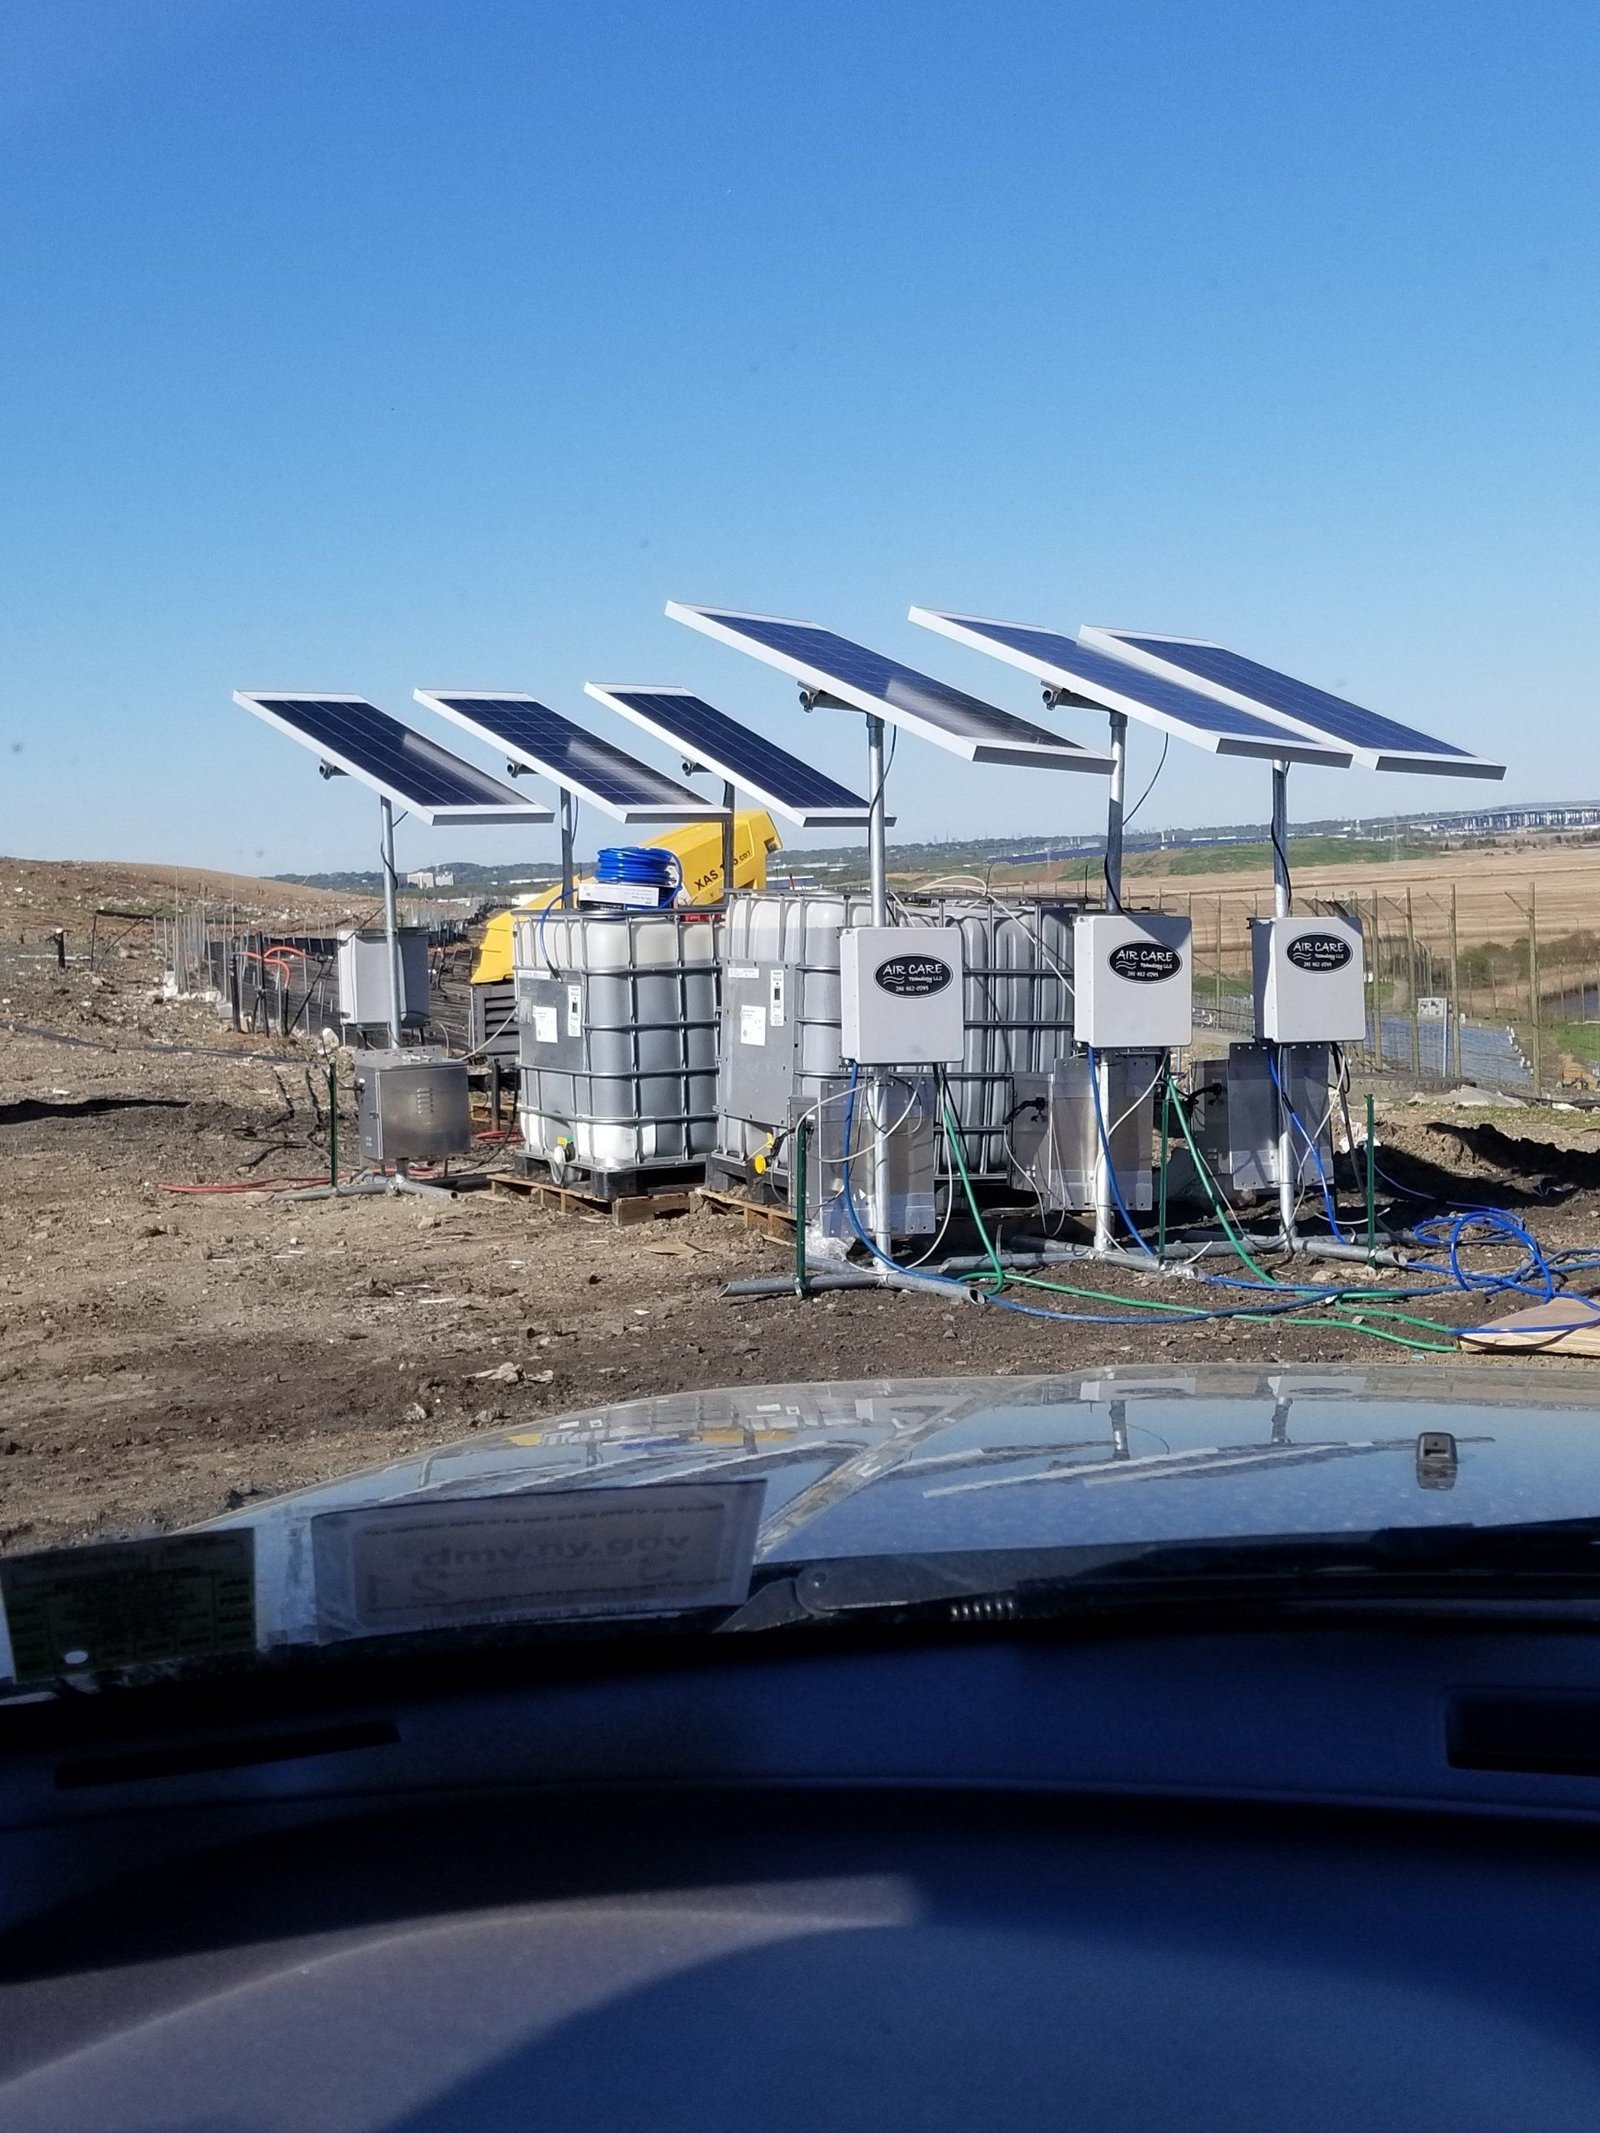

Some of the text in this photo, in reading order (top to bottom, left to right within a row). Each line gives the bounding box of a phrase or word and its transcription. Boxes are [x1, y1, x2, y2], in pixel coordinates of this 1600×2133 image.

[693, 869, 719, 891] XAS
[1293, 941, 1345, 952] AIR CARE
[1116, 949, 1173, 962] AIR CARE
[882, 964, 943, 975] AIR CARE
[422, 1534, 691, 1567] dmv.ny.gov
